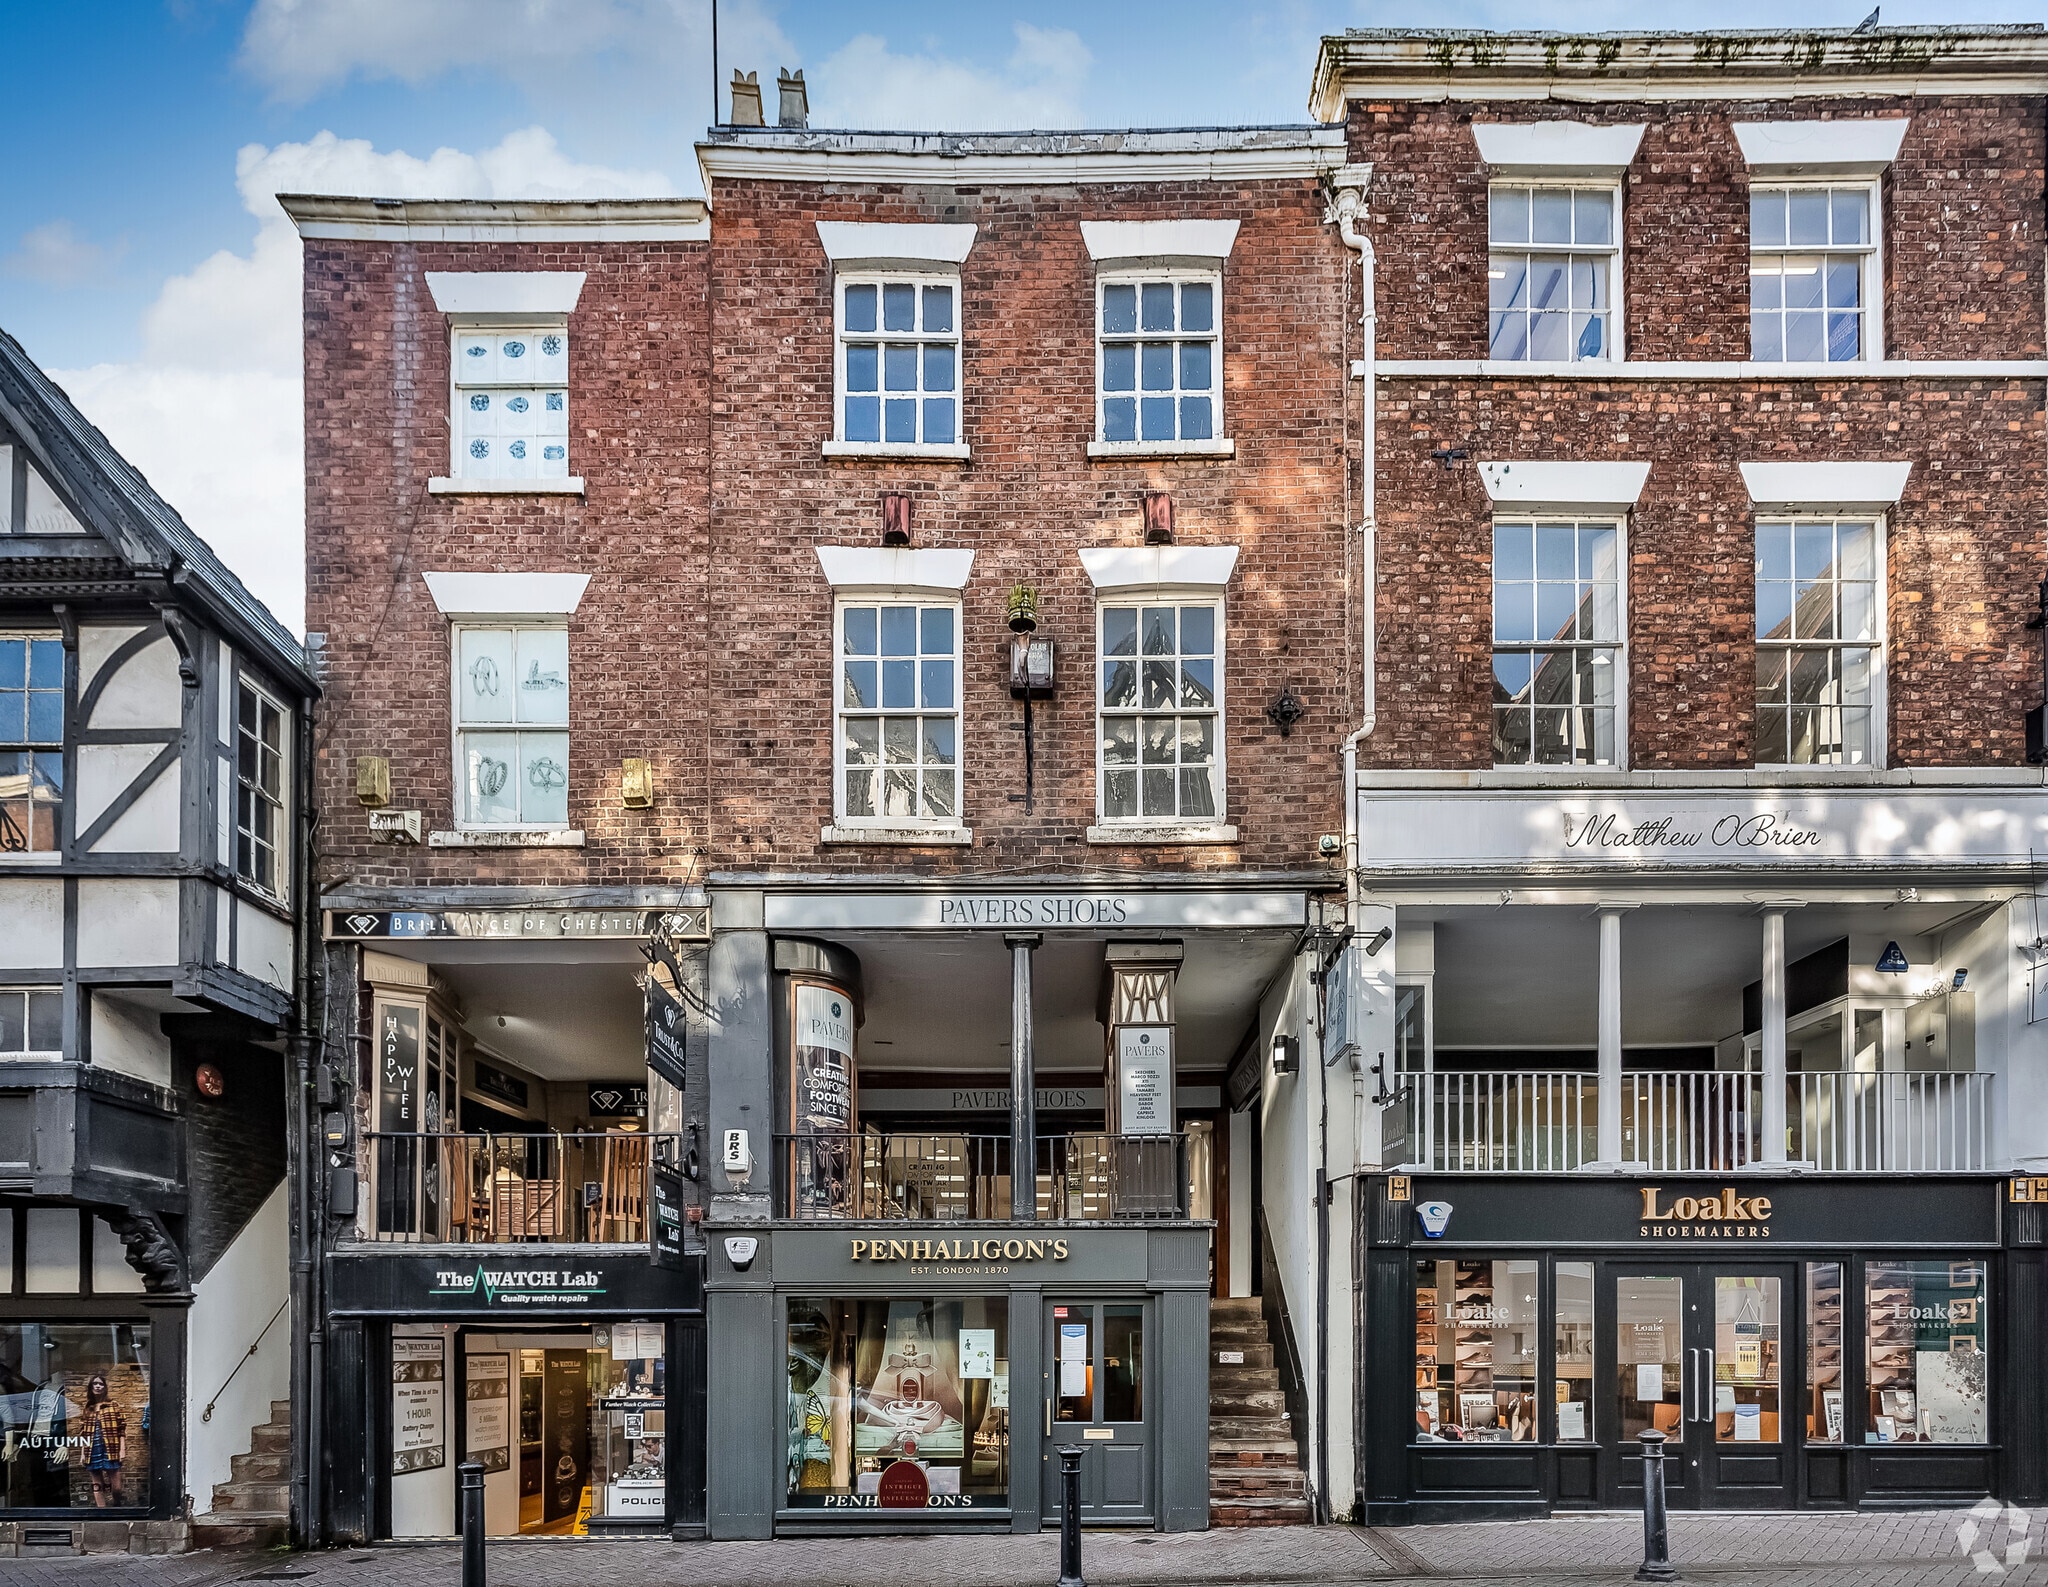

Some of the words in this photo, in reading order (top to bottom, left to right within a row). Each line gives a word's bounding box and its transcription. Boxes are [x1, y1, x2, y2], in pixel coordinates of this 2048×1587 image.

[1566, 813, 1703, 848] Matthew
[939, 899, 1033, 923] PAVERS
[1041, 899, 1127, 923] SHOES
[393, 916, 510, 931] BRILLIANCE
[524, 917, 545, 931] OF
[560, 916, 646, 931] CHESTER
[811, 1018, 850, 1043] PAVERS
[385, 1016, 397, 1084] HAPPY
[1125, 1045, 1165, 1056] PAVERS
[812, 1067, 849, 1085] CREATING
[397, 1065, 414, 1119] WIFE
[952, 1091, 1012, 1108] PAVER
[1035, 1090, 1086, 1107] HOES
[810, 1101, 838, 1115] SINCE
[1383, 1121, 1405, 1144] Loake
[729, 1132, 740, 1160] BRS
[908, 1163, 945, 1171] CRATING
[655, 1184, 666, 1200] The
[659, 1203, 679, 1222] WATCH
[1640, 1187, 1772, 1221] Loake
[668, 1226, 679, 1242] Lab
[1640, 1226, 1770, 1237] SHOEMAKERS
[851, 1239, 1069, 1260] PENHALIGON'S
[911, 1266, 932, 1274] EST.
[936, 1266, 981, 1274] LONDON
[984, 1266, 1009, 1274] 1870
[436, 1271, 475, 1287] The
[483, 1271, 558, 1287] WATCH
[500, 1294, 531, 1304] Quality
[531, 1294, 557, 1303] watch
[558, 1294, 589, 1303] repairs
[1444, 1302, 1509, 1320] Loake
[1893, 1302, 1959, 1320] Loake
[1634, 1323, 1664, 1332] Loake
[394, 1343, 406, 1351] The
[408, 1343, 430, 1351] WATCH
[406, 1410, 411, 1419] 1
[411, 1408, 432, 1419] HOUR
[19, 1436, 91, 1449] AUTUMN
